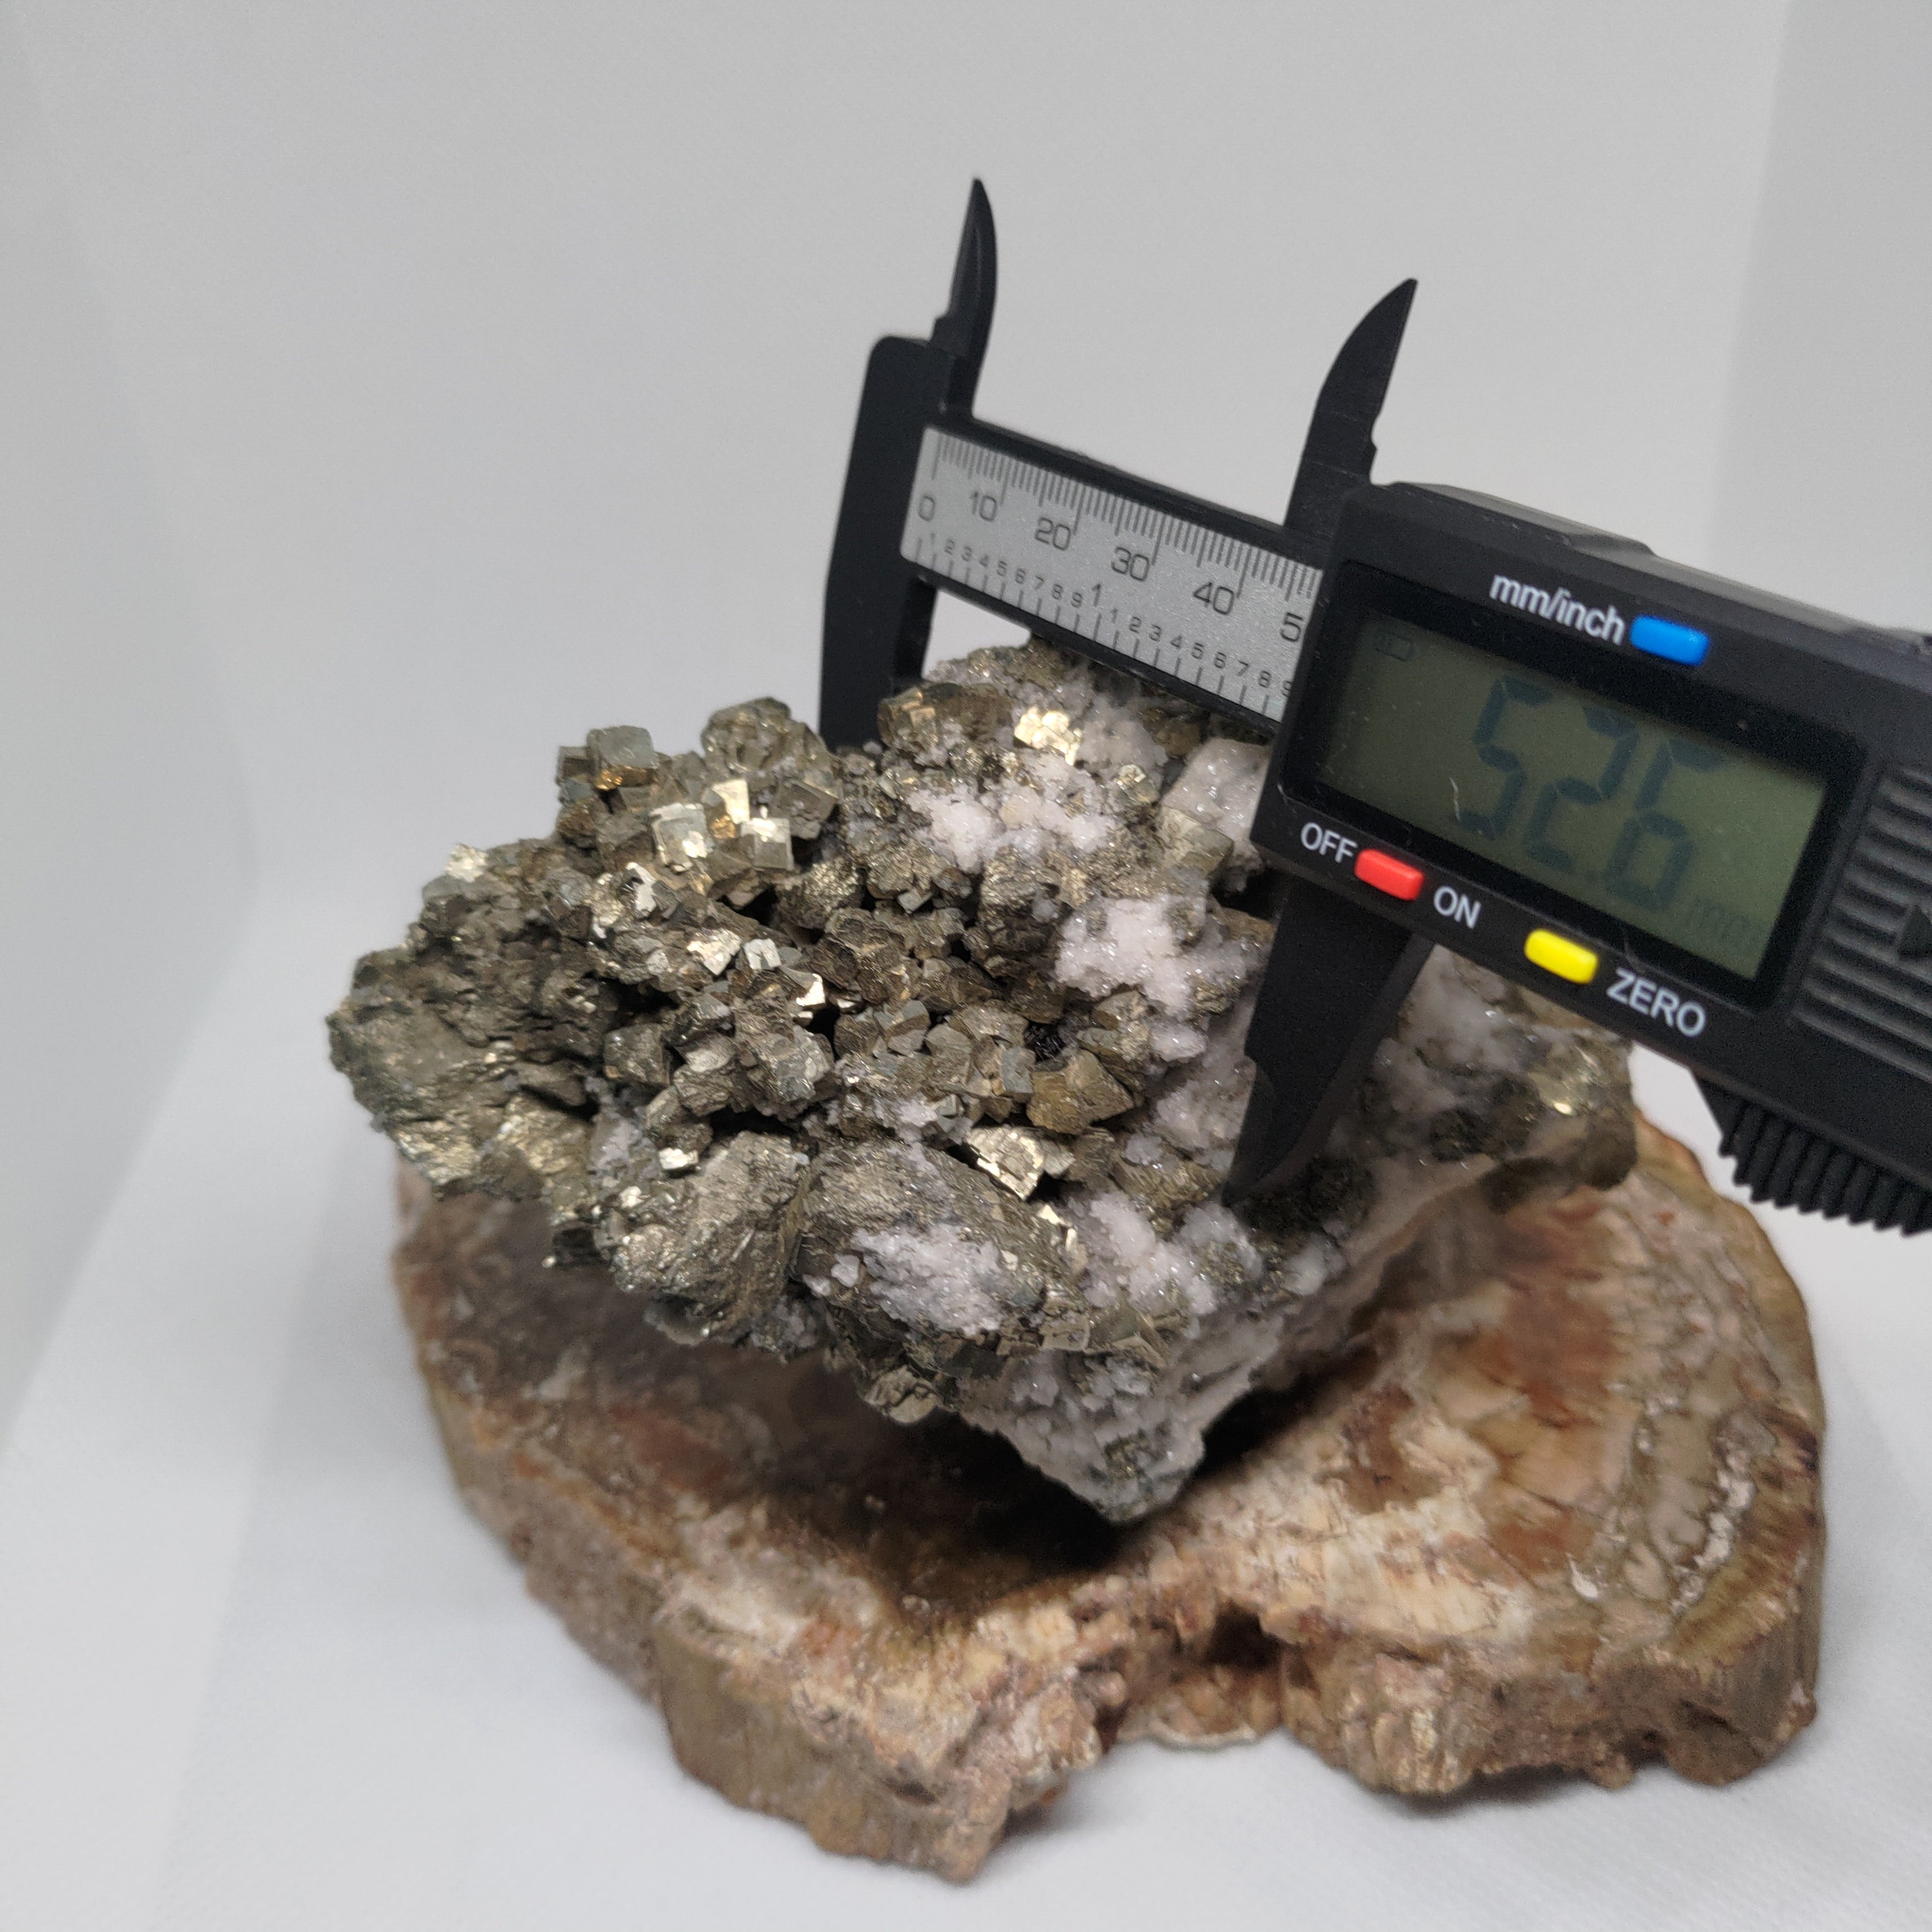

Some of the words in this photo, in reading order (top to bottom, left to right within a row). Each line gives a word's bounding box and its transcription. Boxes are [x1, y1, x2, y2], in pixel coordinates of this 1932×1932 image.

[918, 495, 935, 521] 0
[969, 490, 998, 522] 10
[1034, 517, 1070, 551] 20
[1110, 546, 1150, 582] 30
[1193, 582, 1235, 615] 40
[1280, 612, 1305, 643] 5
[944, 538, 955, 556] 2
[961, 545, 973, 562] 3
[980, 554, 990, 567] 4
[996, 560, 1008, 576] 5
[1015, 567, 1026, 585] 6
[1035, 575, 1045, 591] 7
[1052, 583, 1063, 601] 8
[1071, 592, 1083, 608] 9
[1091, 583, 1102, 607] 1
[1111, 608, 1118, 624] 1
[1129, 616, 1142, 634] 2
[1148, 625, 1162, 642] 3
[1170, 634, 1183, 649] 4
[1191, 642, 1205, 660] 5
[1214, 651, 1227, 669] 6
[1238, 660, 1250, 677] 7
[1258, 670, 1272, 688] 8
[1490, 574, 1626, 646] mm/inch
[1300, 822, 1358, 864] OFF
[1433, 886, 1482, 929] ON
[1606, 967, 1706, 1037] ZERO
